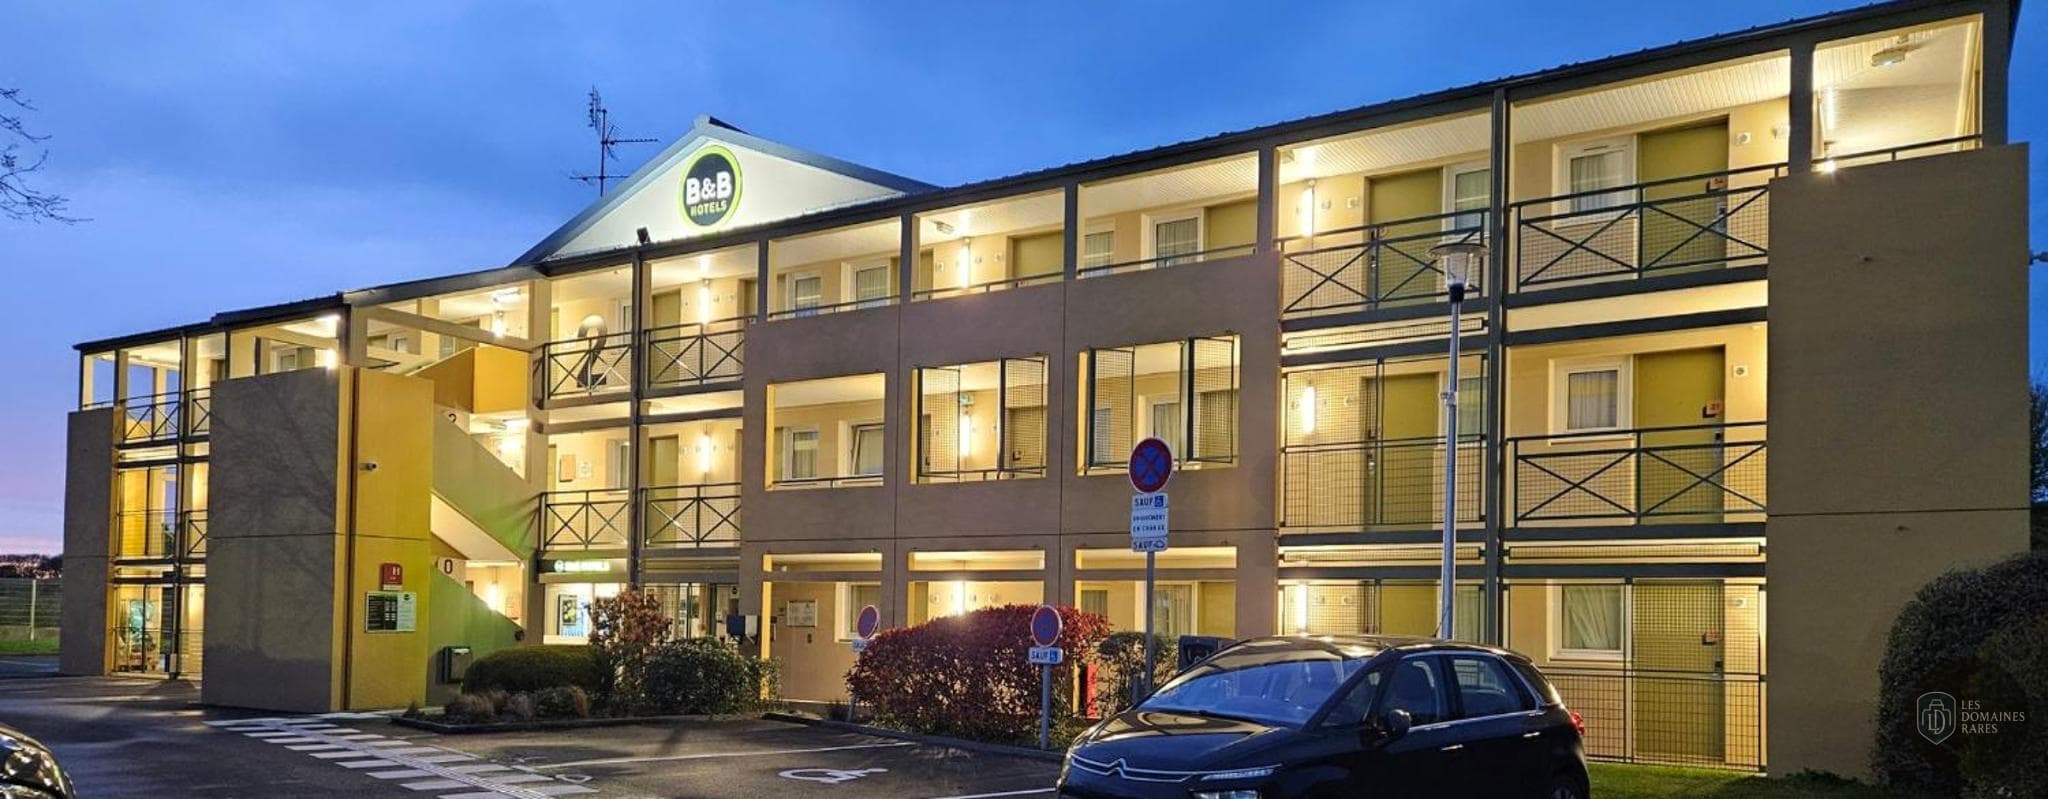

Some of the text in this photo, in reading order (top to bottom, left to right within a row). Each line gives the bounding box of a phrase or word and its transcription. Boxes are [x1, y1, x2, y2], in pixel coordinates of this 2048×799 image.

[685, 171, 732, 206] B&B
[690, 200, 727, 216] HOTELS
[1134, 496, 1153, 507] SAUF
